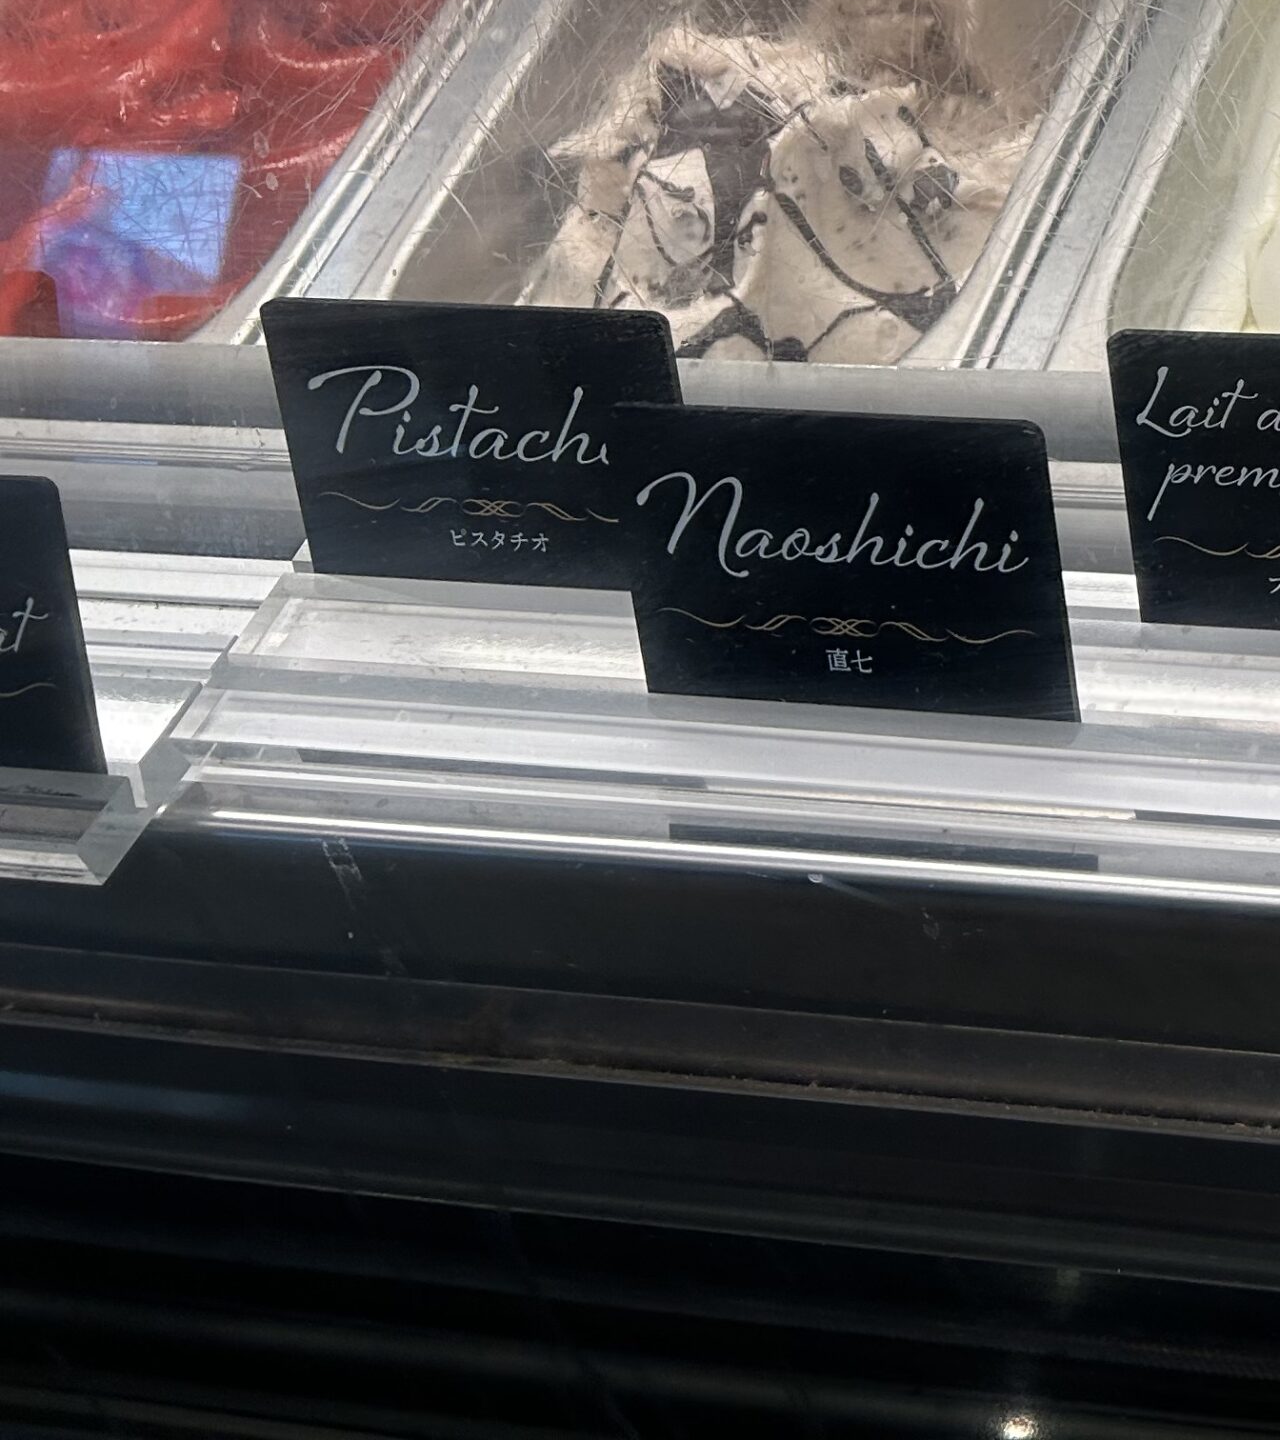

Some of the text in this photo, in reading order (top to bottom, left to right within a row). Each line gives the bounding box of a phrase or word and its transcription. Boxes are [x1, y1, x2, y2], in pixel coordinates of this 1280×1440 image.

[1136, 366, 1258, 438] Lait
[450, 528, 549, 553] ピスタチオ
[636, 472, 1029, 578] Naoshichi
[825, 647, 873, 674] 直七
